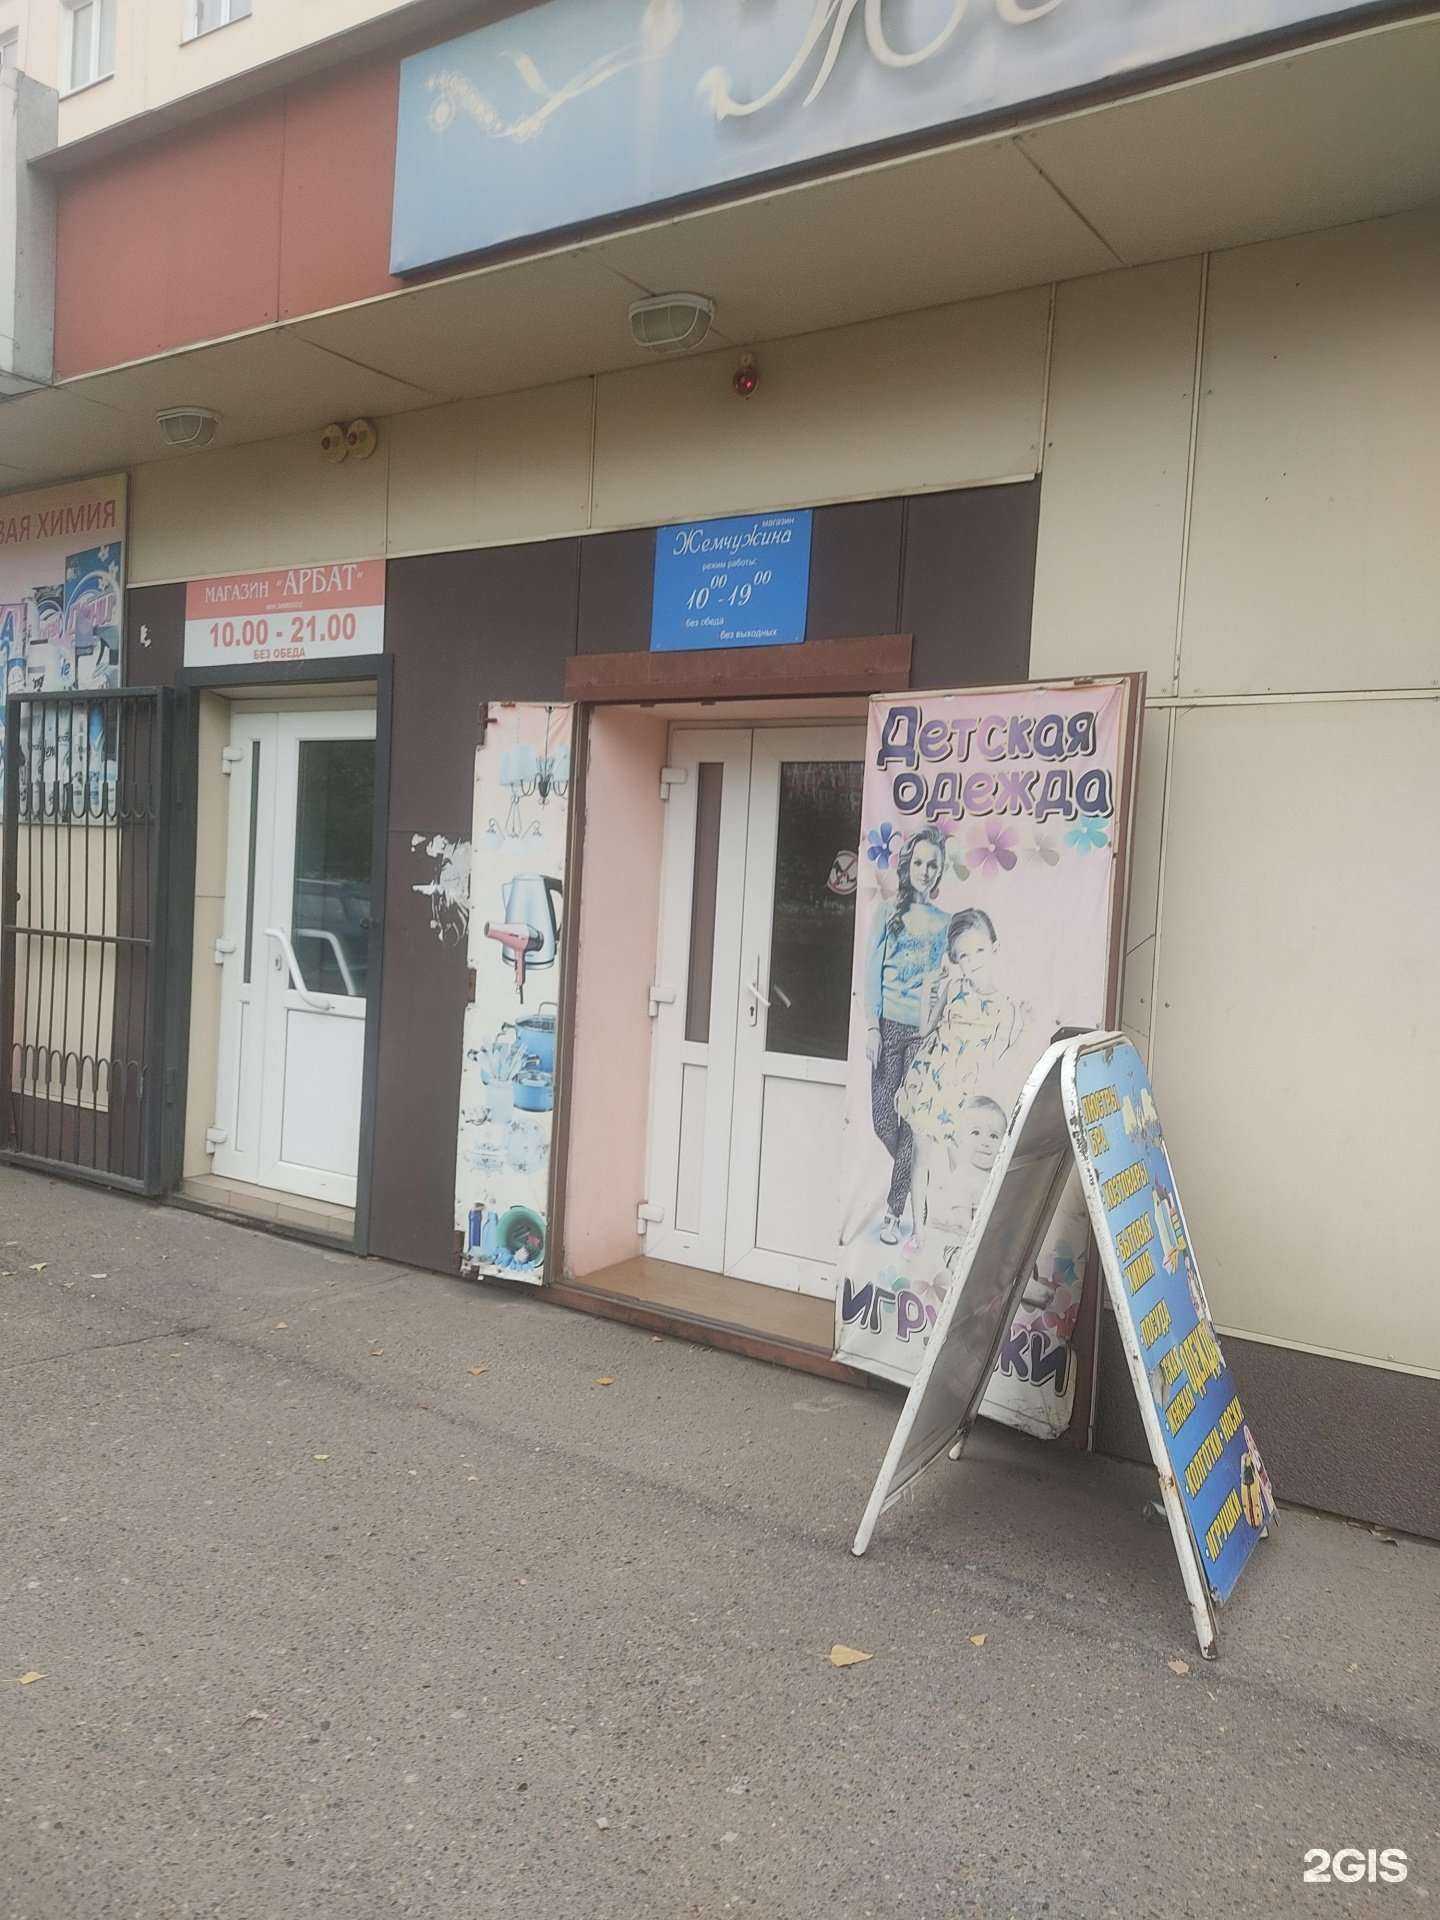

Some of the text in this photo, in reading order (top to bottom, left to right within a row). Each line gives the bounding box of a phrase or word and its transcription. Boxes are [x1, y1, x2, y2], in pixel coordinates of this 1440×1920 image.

[36, 499, 116, 539] ХИМИЯ
[673, 524, 792, 556] Жемчужина
[205, 580, 269, 604] МАГАЗИН
[210, 619, 269, 648] 10.00
[290, 612, 356, 643] 21.00
[254, 647, 306, 660] БЕЗ ОБЕДА
[876, 705, 1099, 771] Детская
[892, 767, 1115, 823] одежда
[1116, 1211, 1154, 1262] БЫТОВАЯ
[1122, 1248, 1155, 1296] ХИМИЯ
[1140, 1296, 1171, 1350] ПОСУДА
[1166, 1381, 1196, 1438] ЖЕНСКАЯ
[1184, 1393, 1245, 1500] КОЛГОТКИ НОСКИ
[1206, 1488, 1243, 1563] ИГРУШКИ
